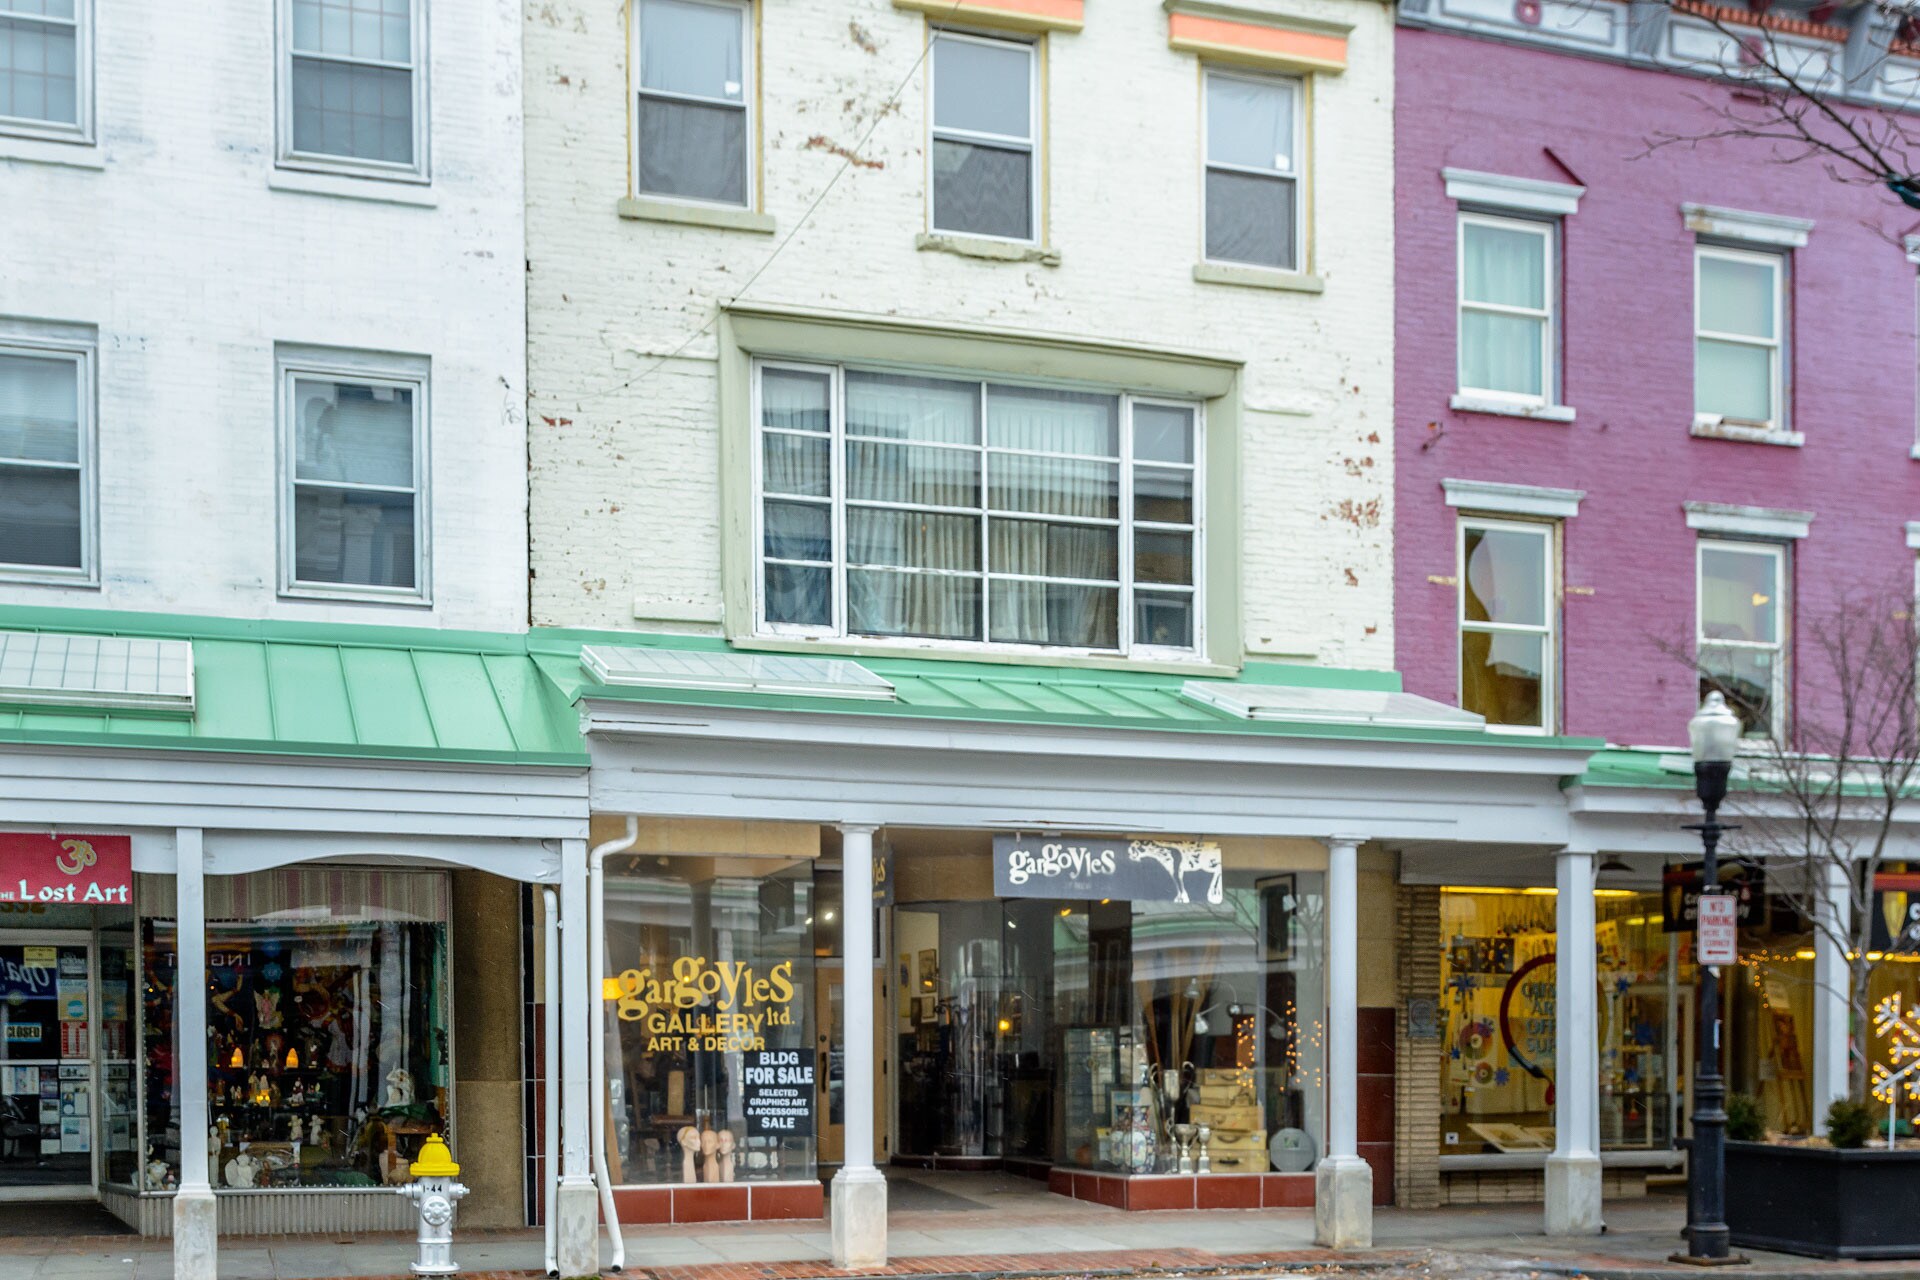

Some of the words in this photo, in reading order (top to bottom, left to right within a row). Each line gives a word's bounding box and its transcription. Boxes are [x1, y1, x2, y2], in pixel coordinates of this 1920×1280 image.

[1009, 844, 1115, 884] gargoyles
[0, 891, 14, 900] HE
[19, 879, 76, 902] Lost
[83, 882, 128, 903] Art
[1710, 902, 1725, 912] NO
[1701, 915, 1733, 925] PARKING
[618, 956, 794, 1021] gargoyles
[647, 1013, 764, 1034] GALLERY
[767, 1006, 796, 1026] ltd.
[6, 1026, 40, 1038] CLOSED
[647, 1036, 683, 1051] ART
[688, 1036, 699, 1051] &
[705, 1036, 766, 1051] DECOR
[759, 1051, 799, 1065] BLDG
[745, 1067, 775, 1085] FOR
[777, 1066, 814, 1084] SALE
[758, 1088, 799, 1097] SELECTED
[749, 1097, 790, 1106] GRAPHICS
[791, 1098, 807, 1106] ART
[747, 1107, 754, 1115] &
[755, 1107, 809, 1116] ACCESSORIES
[761, 1116, 796, 1129] SALE
